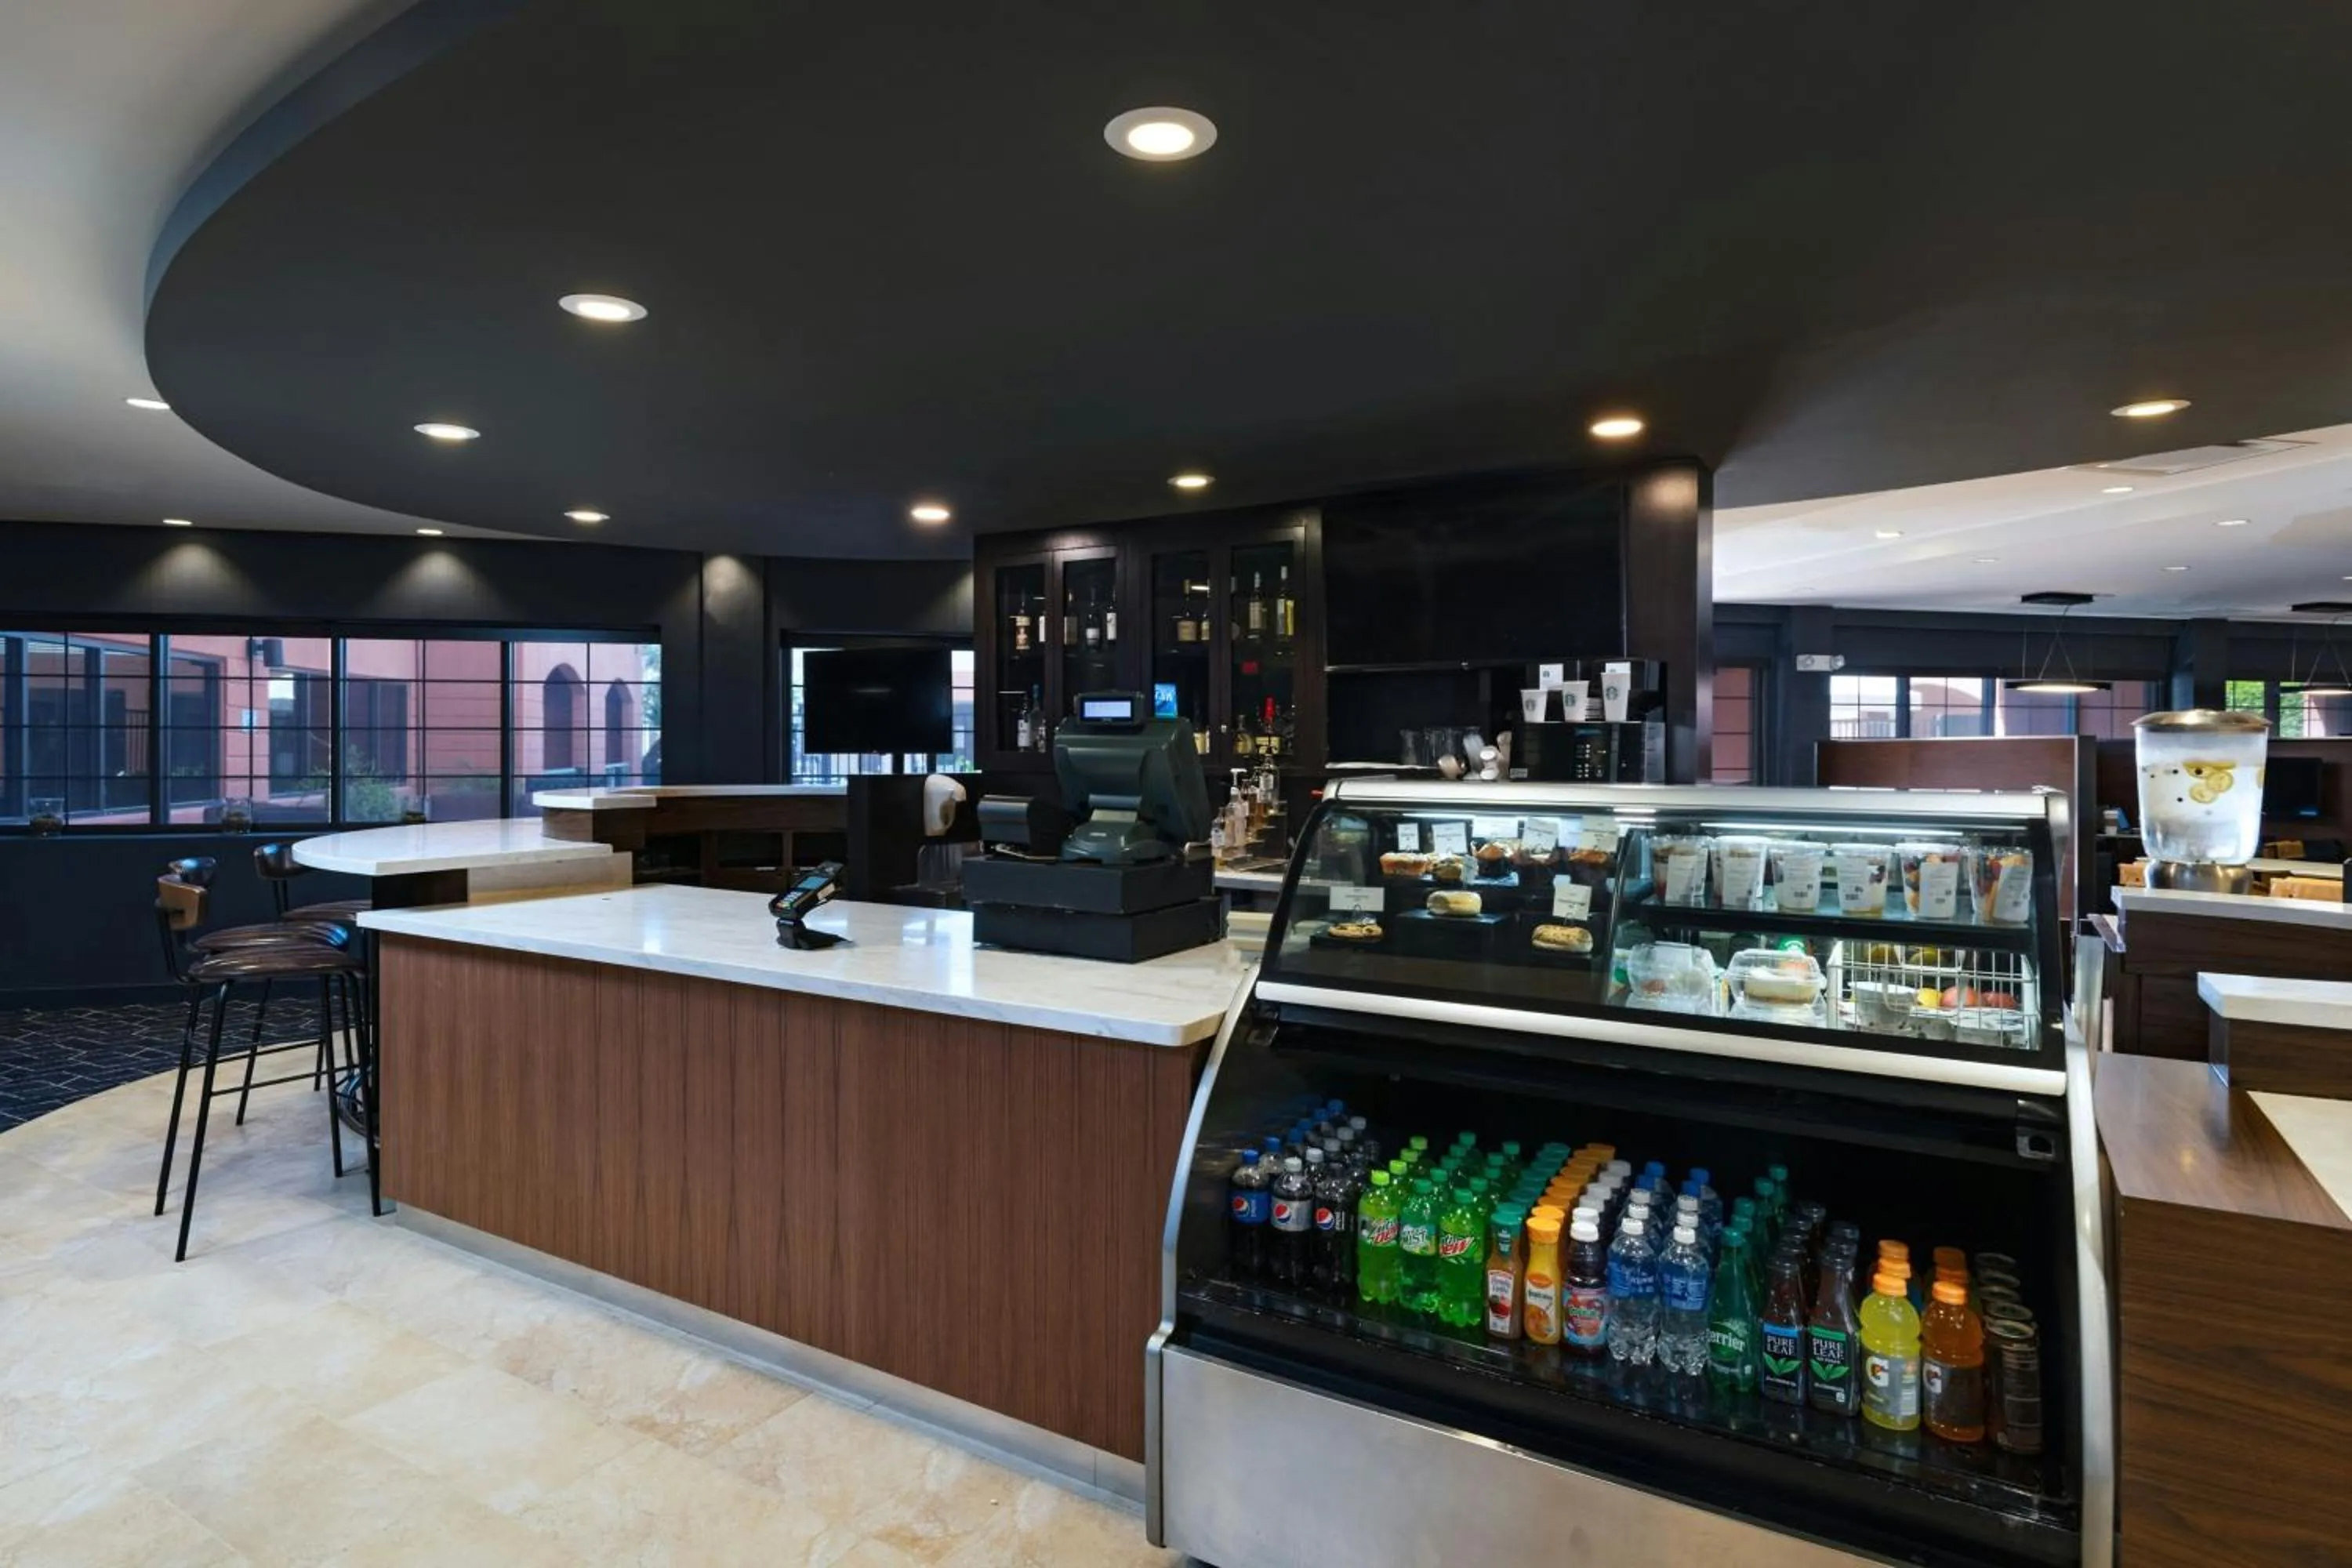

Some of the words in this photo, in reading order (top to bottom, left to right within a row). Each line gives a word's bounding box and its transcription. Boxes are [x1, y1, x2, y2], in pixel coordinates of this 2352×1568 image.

[1766, 1335, 1794, 1347] PURE
[1813, 1338, 1843, 1350] PURE
[1766, 1342, 1795, 1356] LEAF
[1813, 1345, 1844, 1360] LEAF
